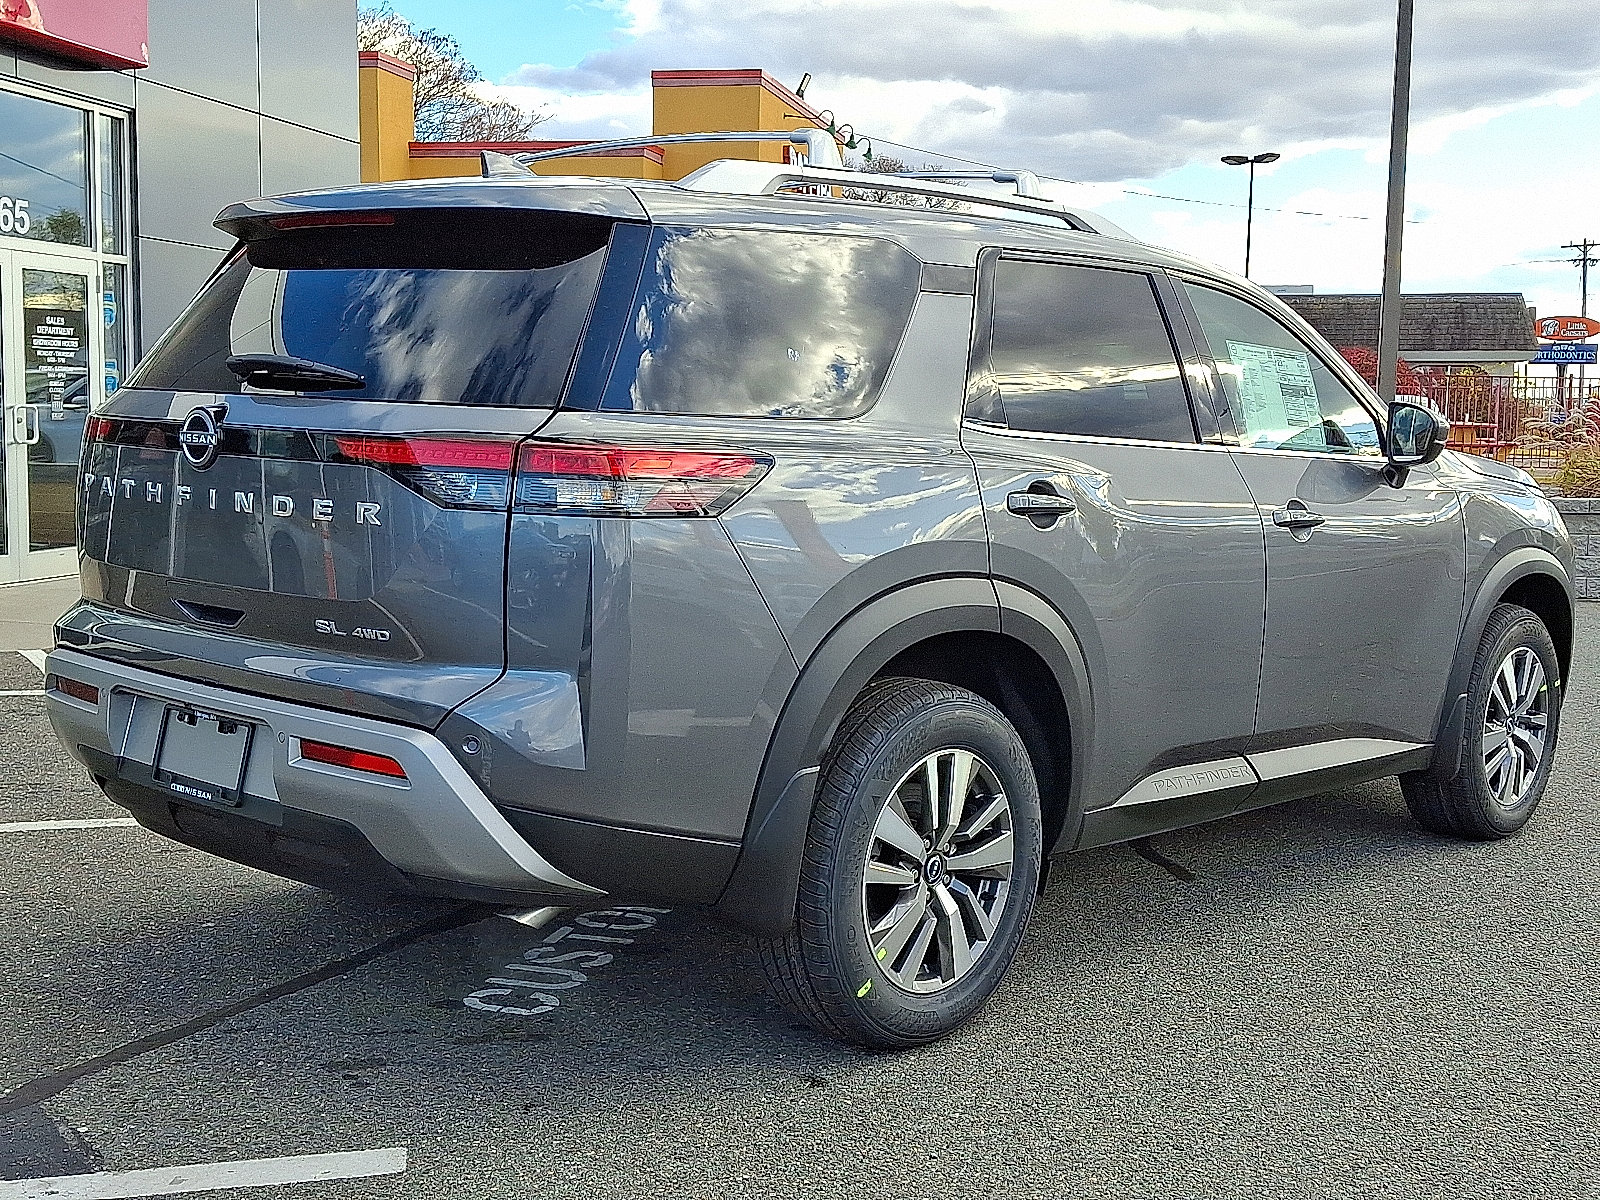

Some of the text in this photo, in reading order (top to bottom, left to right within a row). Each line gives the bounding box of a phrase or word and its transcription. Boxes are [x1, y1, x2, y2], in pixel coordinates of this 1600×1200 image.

[45, 316, 65, 326] SALES
[1567, 322, 1586, 330] Little
[36, 326, 75, 336] DEPARTMENT
[1535, 351, 1596, 359] RTHODONTICS
[180, 433, 216, 444] NISSAN
[84, 472, 382, 527] PATHFINDER
[315, 619, 391, 641] SL 4WD
[1151, 764, 1250, 793] PATHFINDER
